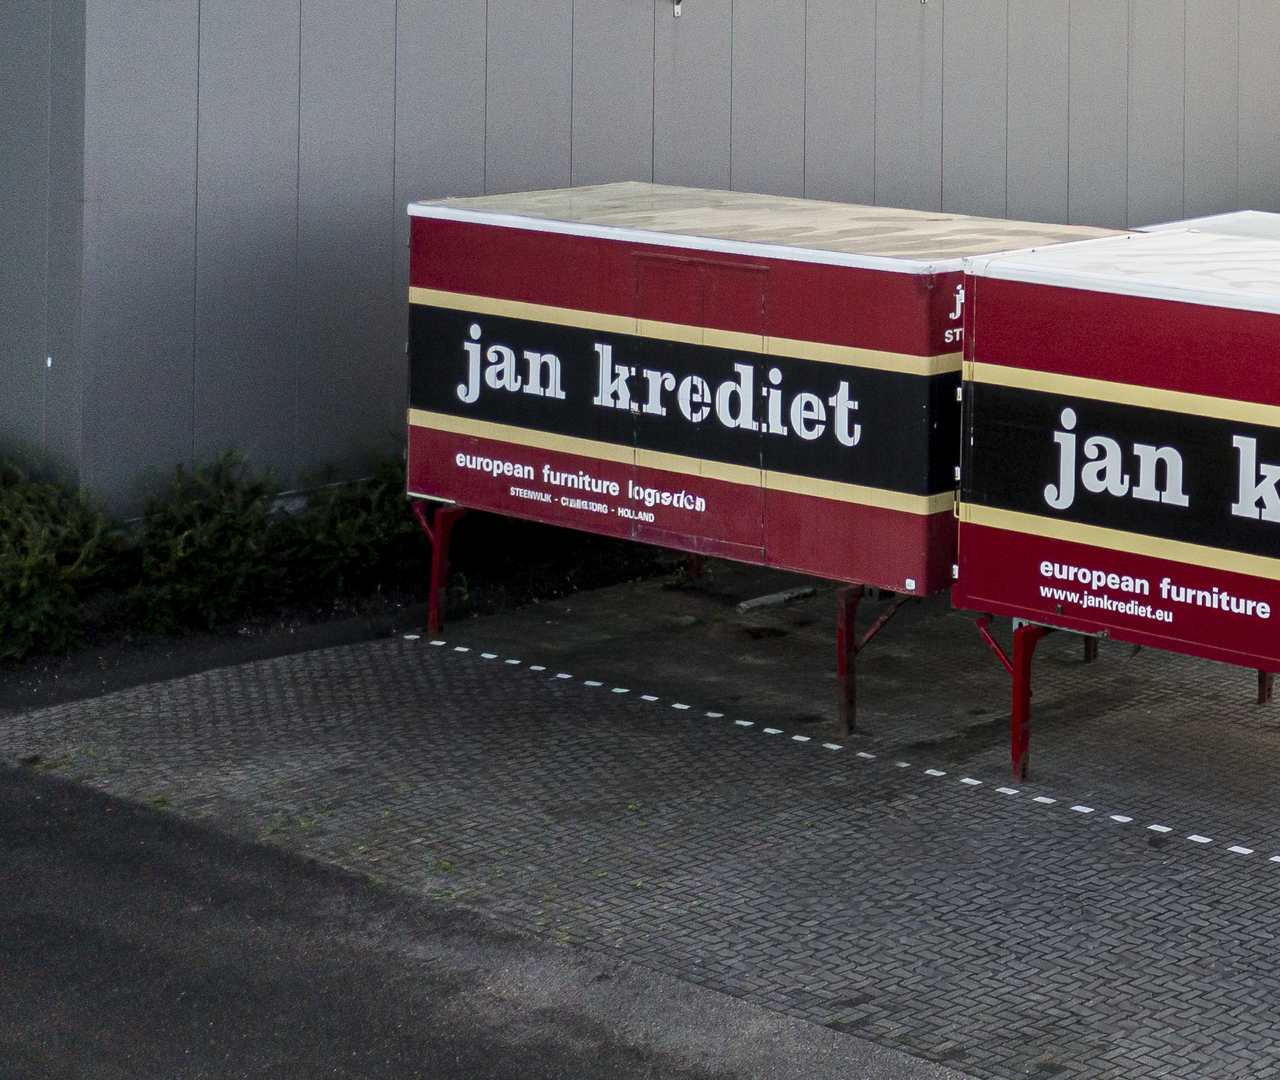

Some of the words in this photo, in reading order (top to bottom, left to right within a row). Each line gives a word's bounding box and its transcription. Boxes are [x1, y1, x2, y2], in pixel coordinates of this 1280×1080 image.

[456, 323, 566, 404] jan
[593, 342, 863, 448] krediet
[455, 452, 535, 478] european
[542, 464, 620, 497] furniture
[1043, 407, 1190, 510] jan
[510, 486, 552, 504] STEENWIJK
[1039, 560, 1150, 596] european
[1159, 577, 1271, 619] furniture
[1039, 584, 1173, 623] www.jankrediet.eu
